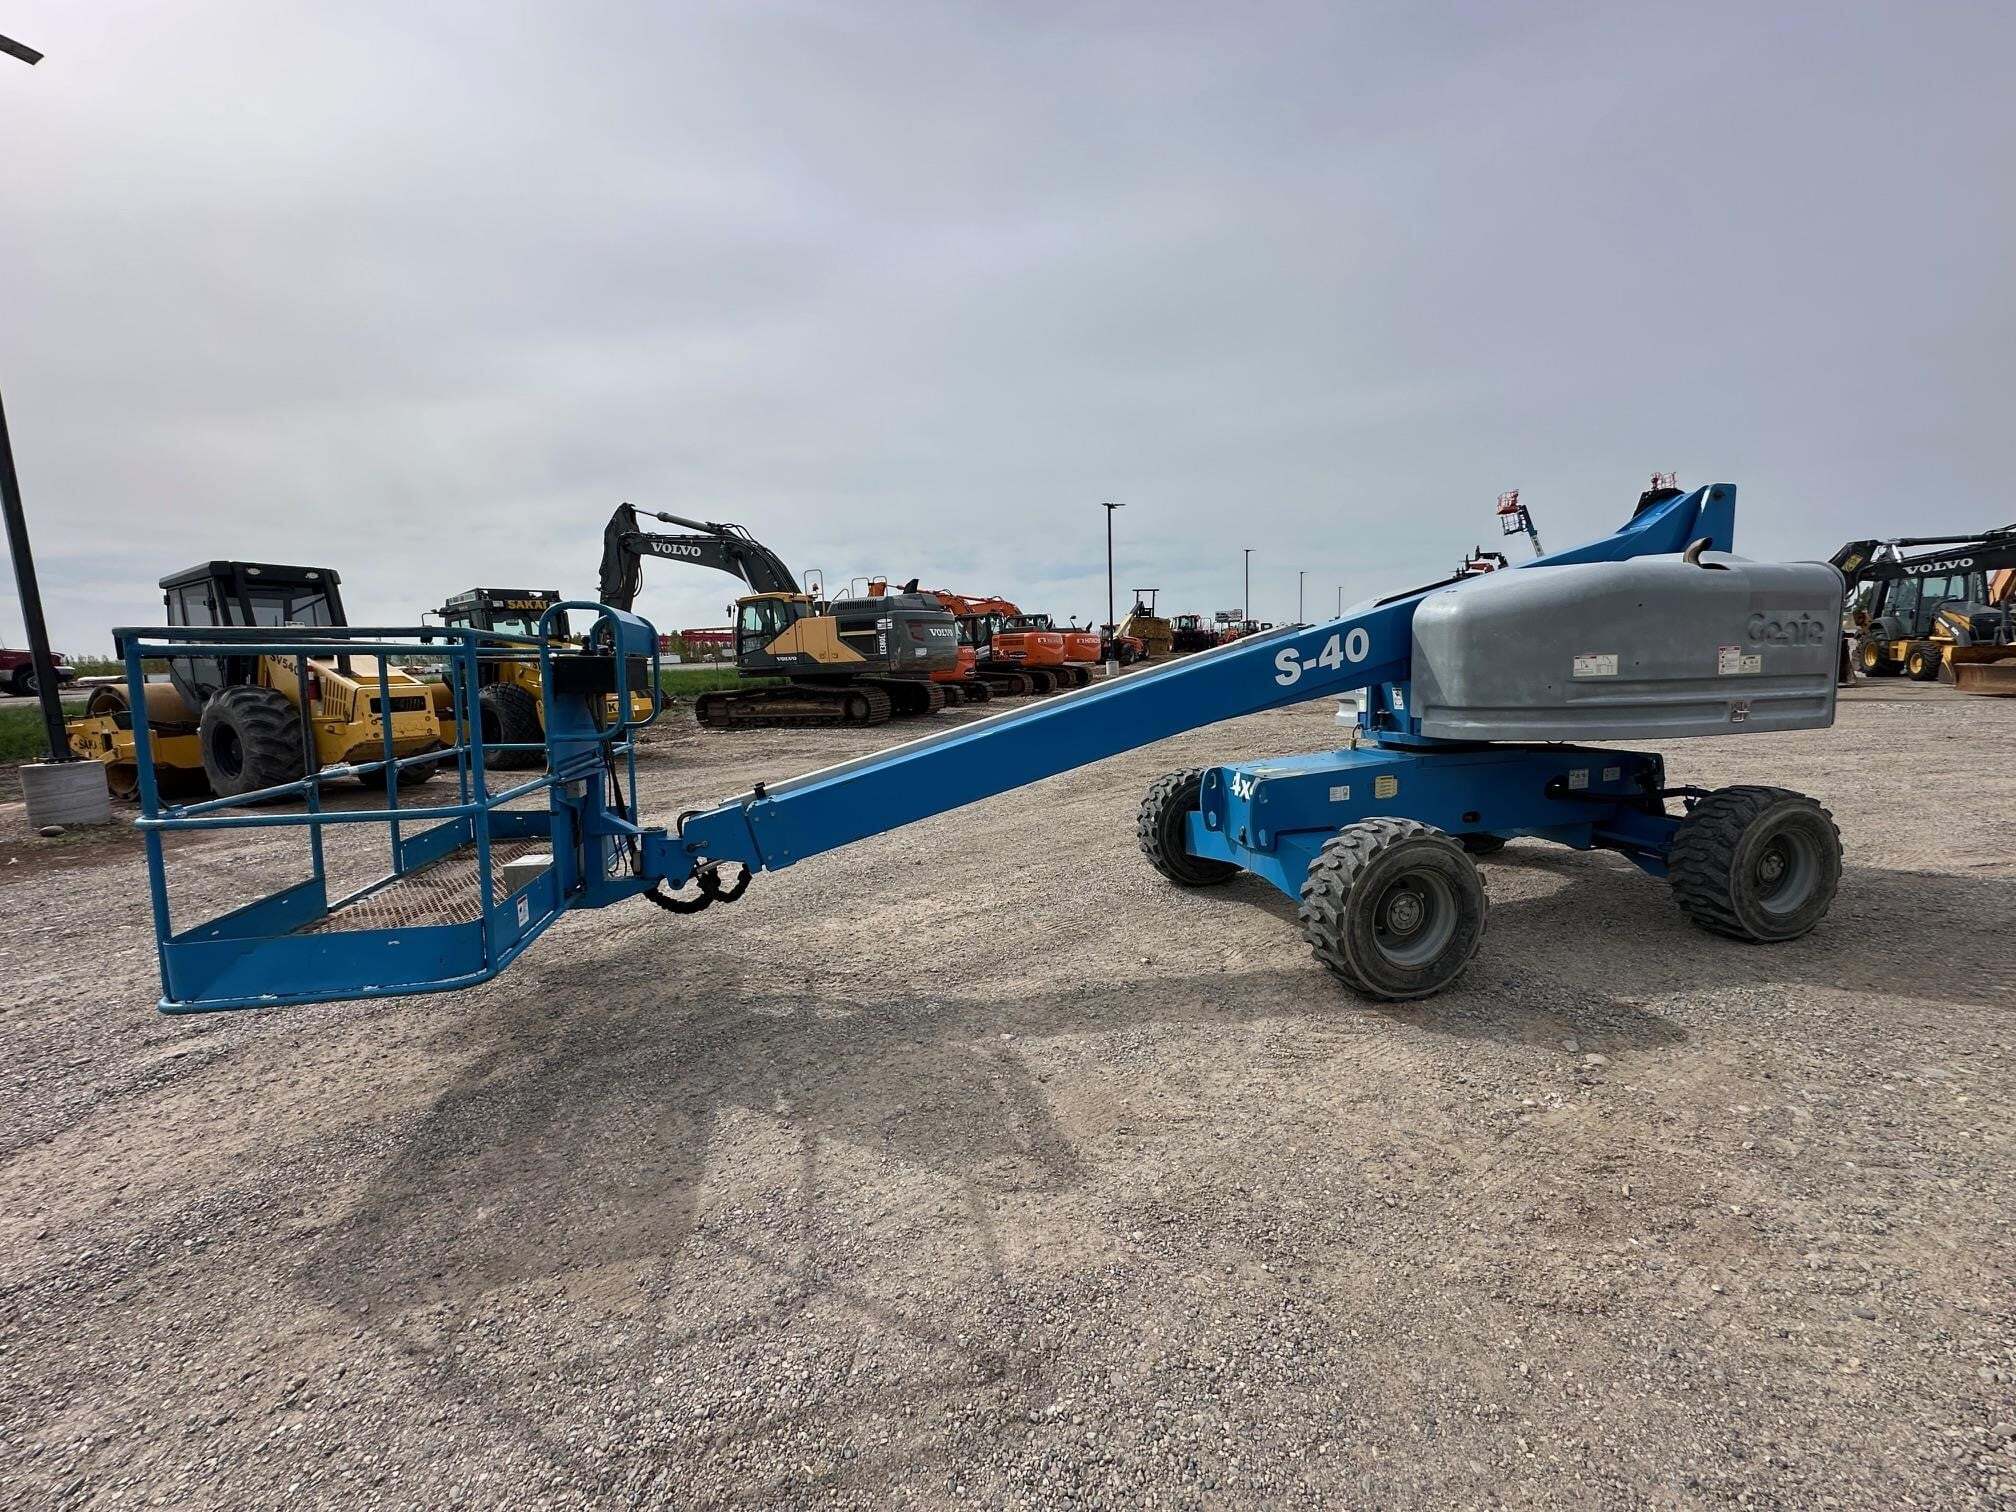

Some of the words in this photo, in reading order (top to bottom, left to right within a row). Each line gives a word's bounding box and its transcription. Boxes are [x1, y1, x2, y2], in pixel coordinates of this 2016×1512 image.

[650, 541, 702, 557] VOLVO
[1902, 558, 1974, 575] VOLVO
[929, 628, 954, 638] VOLVO
[1747, 611, 1825, 647] Genie
[1274, 627, 1370, 686] S-40
